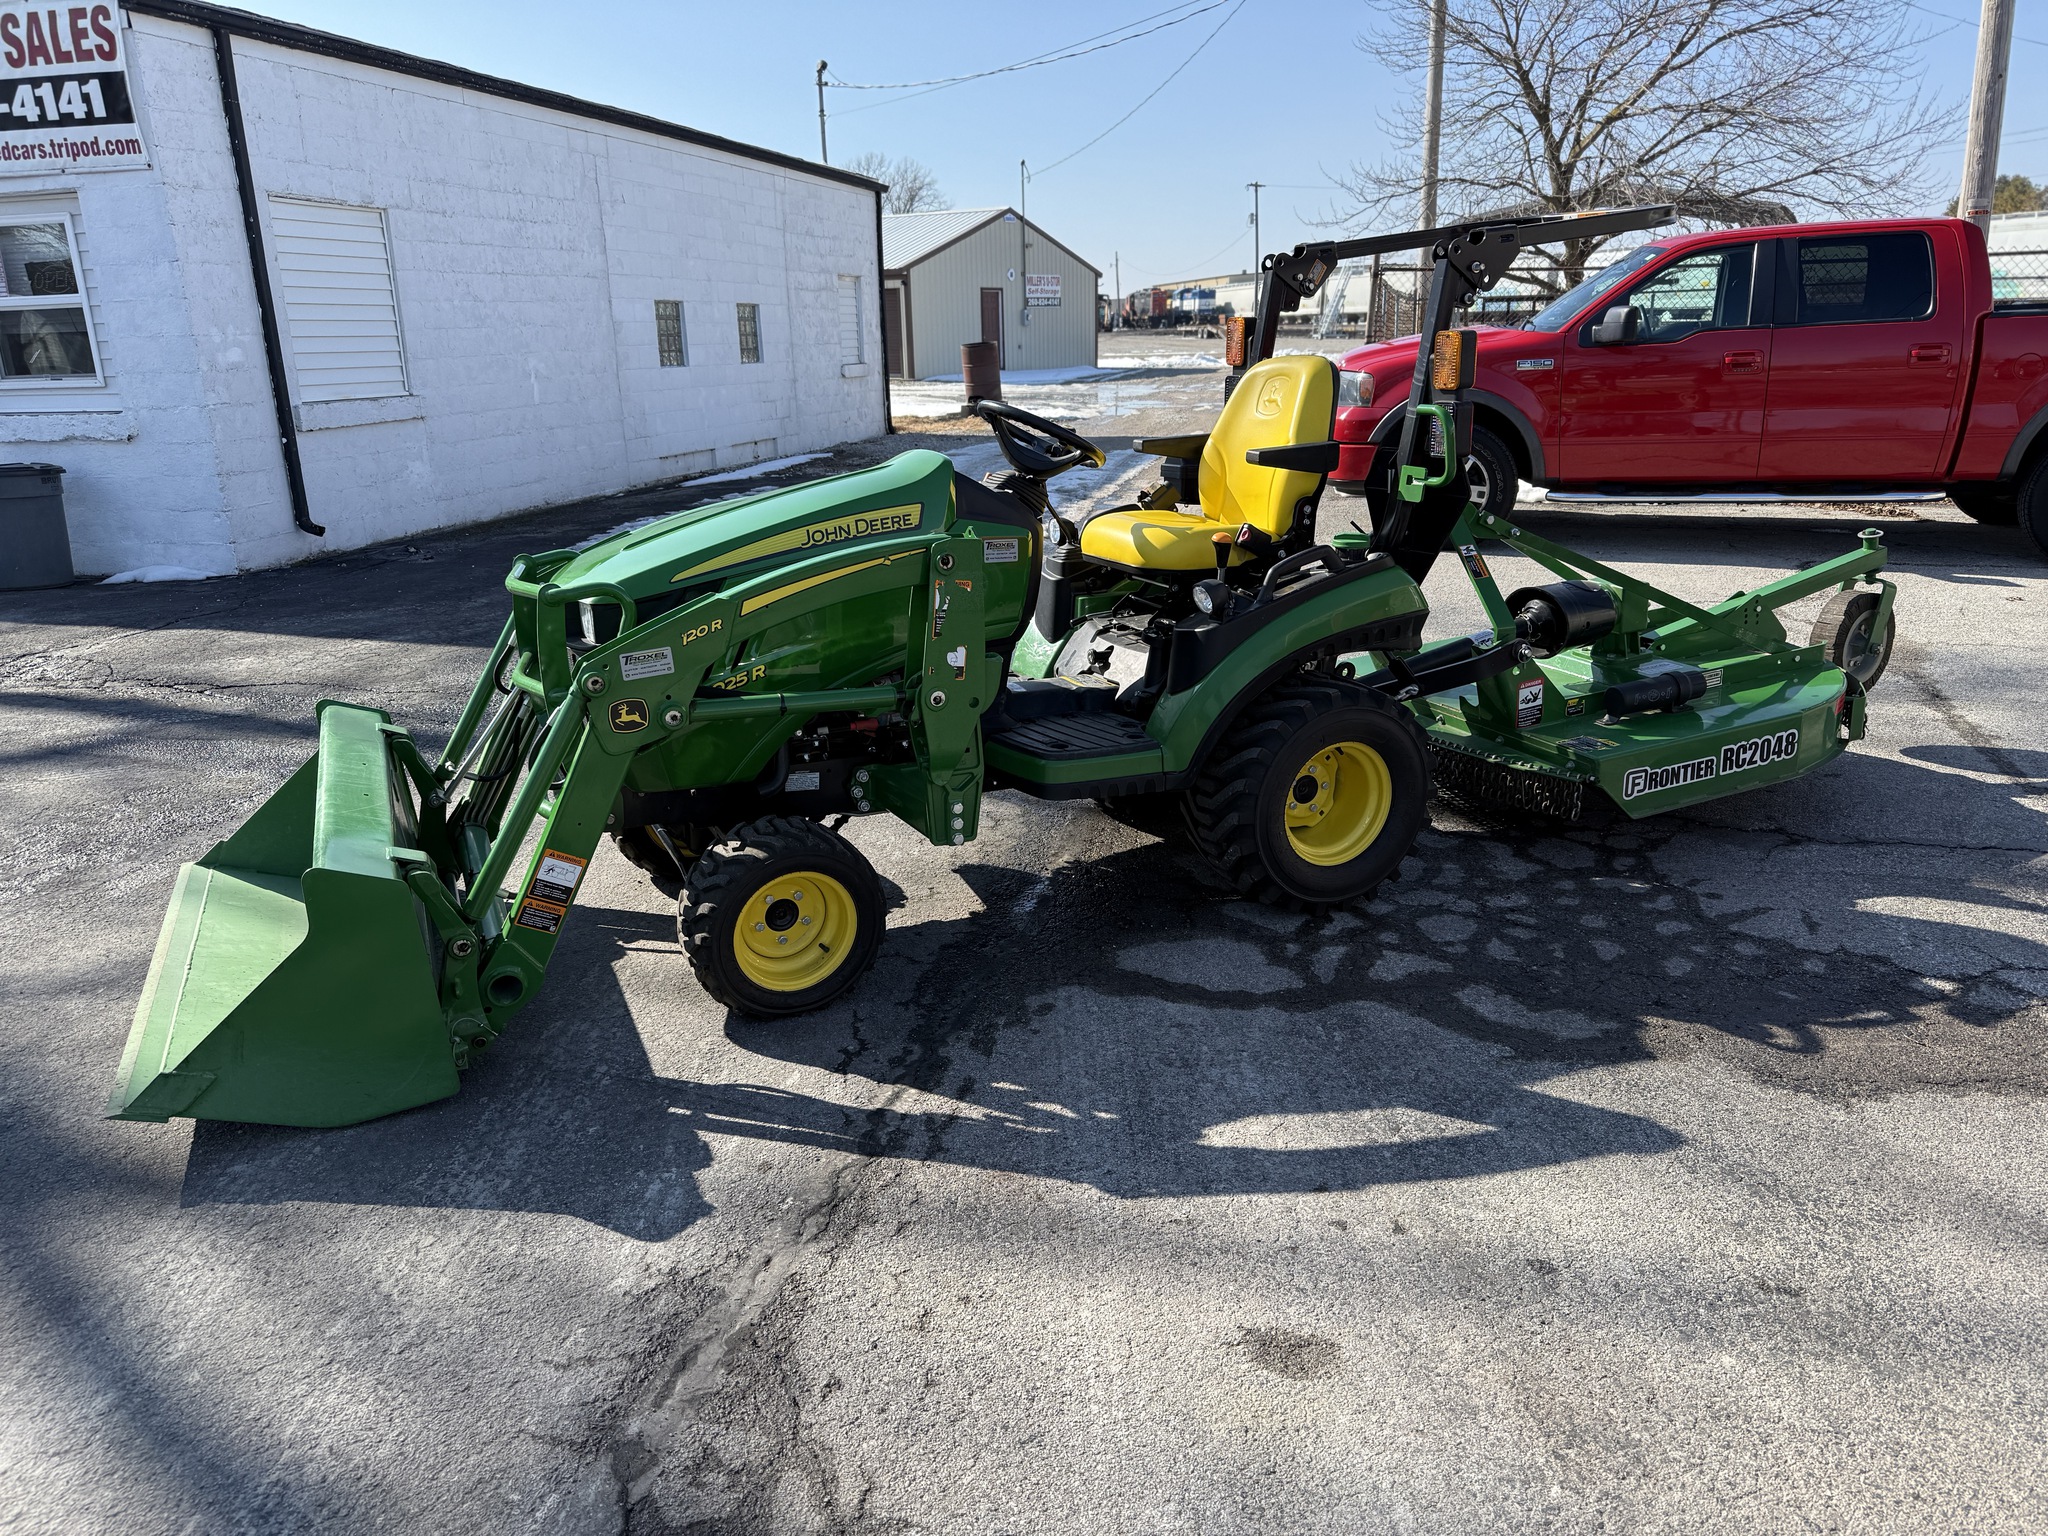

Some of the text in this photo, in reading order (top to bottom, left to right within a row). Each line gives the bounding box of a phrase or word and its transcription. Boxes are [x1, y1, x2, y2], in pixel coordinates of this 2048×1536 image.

[0, 4, 118, 69] SALES
[0, 78, 107, 122] -4141
[0, 136, 142, 162] dcars.tripod.com
[1027, 287, 1060, 297] Self-Storage
[800, 513, 914, 547] JOHN DEERE
[986, 541, 1015, 550] TROXEL
[711, 618, 723, 633] R
[622, 651, 668, 666] TROXEL
[752, 664, 766, 681] R
[1623, 730, 1798, 799] FRONTIER RC2048
[556, 853, 582, 865] WARNING
[535, 903, 562, 914] WARNING
